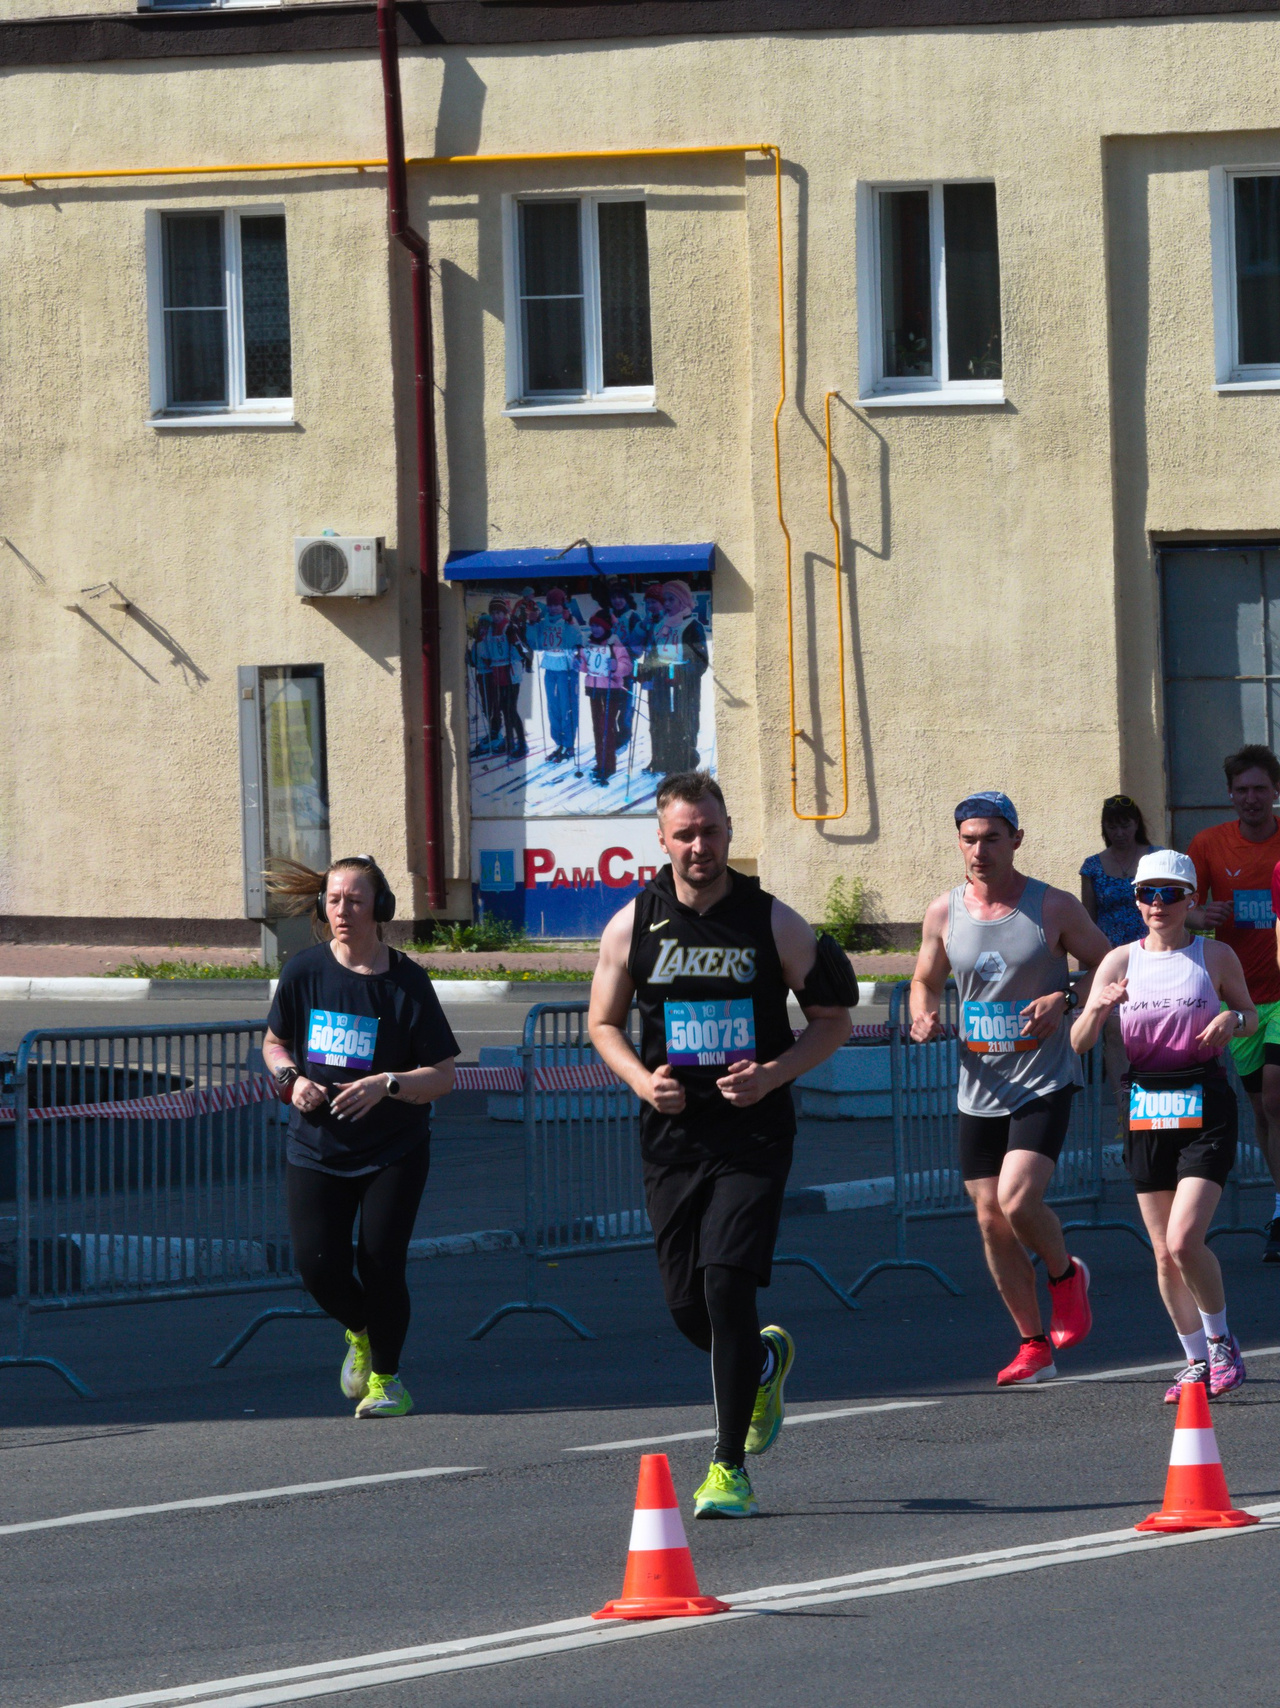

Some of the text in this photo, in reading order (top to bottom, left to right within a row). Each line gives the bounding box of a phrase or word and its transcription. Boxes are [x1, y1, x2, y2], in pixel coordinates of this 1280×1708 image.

[1152, 998, 1171, 1008] WE
[1176, 997, 1208, 1009] TRUST
[309, 1024, 372, 1057] 50205
[671, 1017, 749, 1051] 50073
[325, 1053, 347, 1068] 10KM
[697, 1051, 726, 1066] 10KM
[1135, 1090, 1198, 1117] 70067
